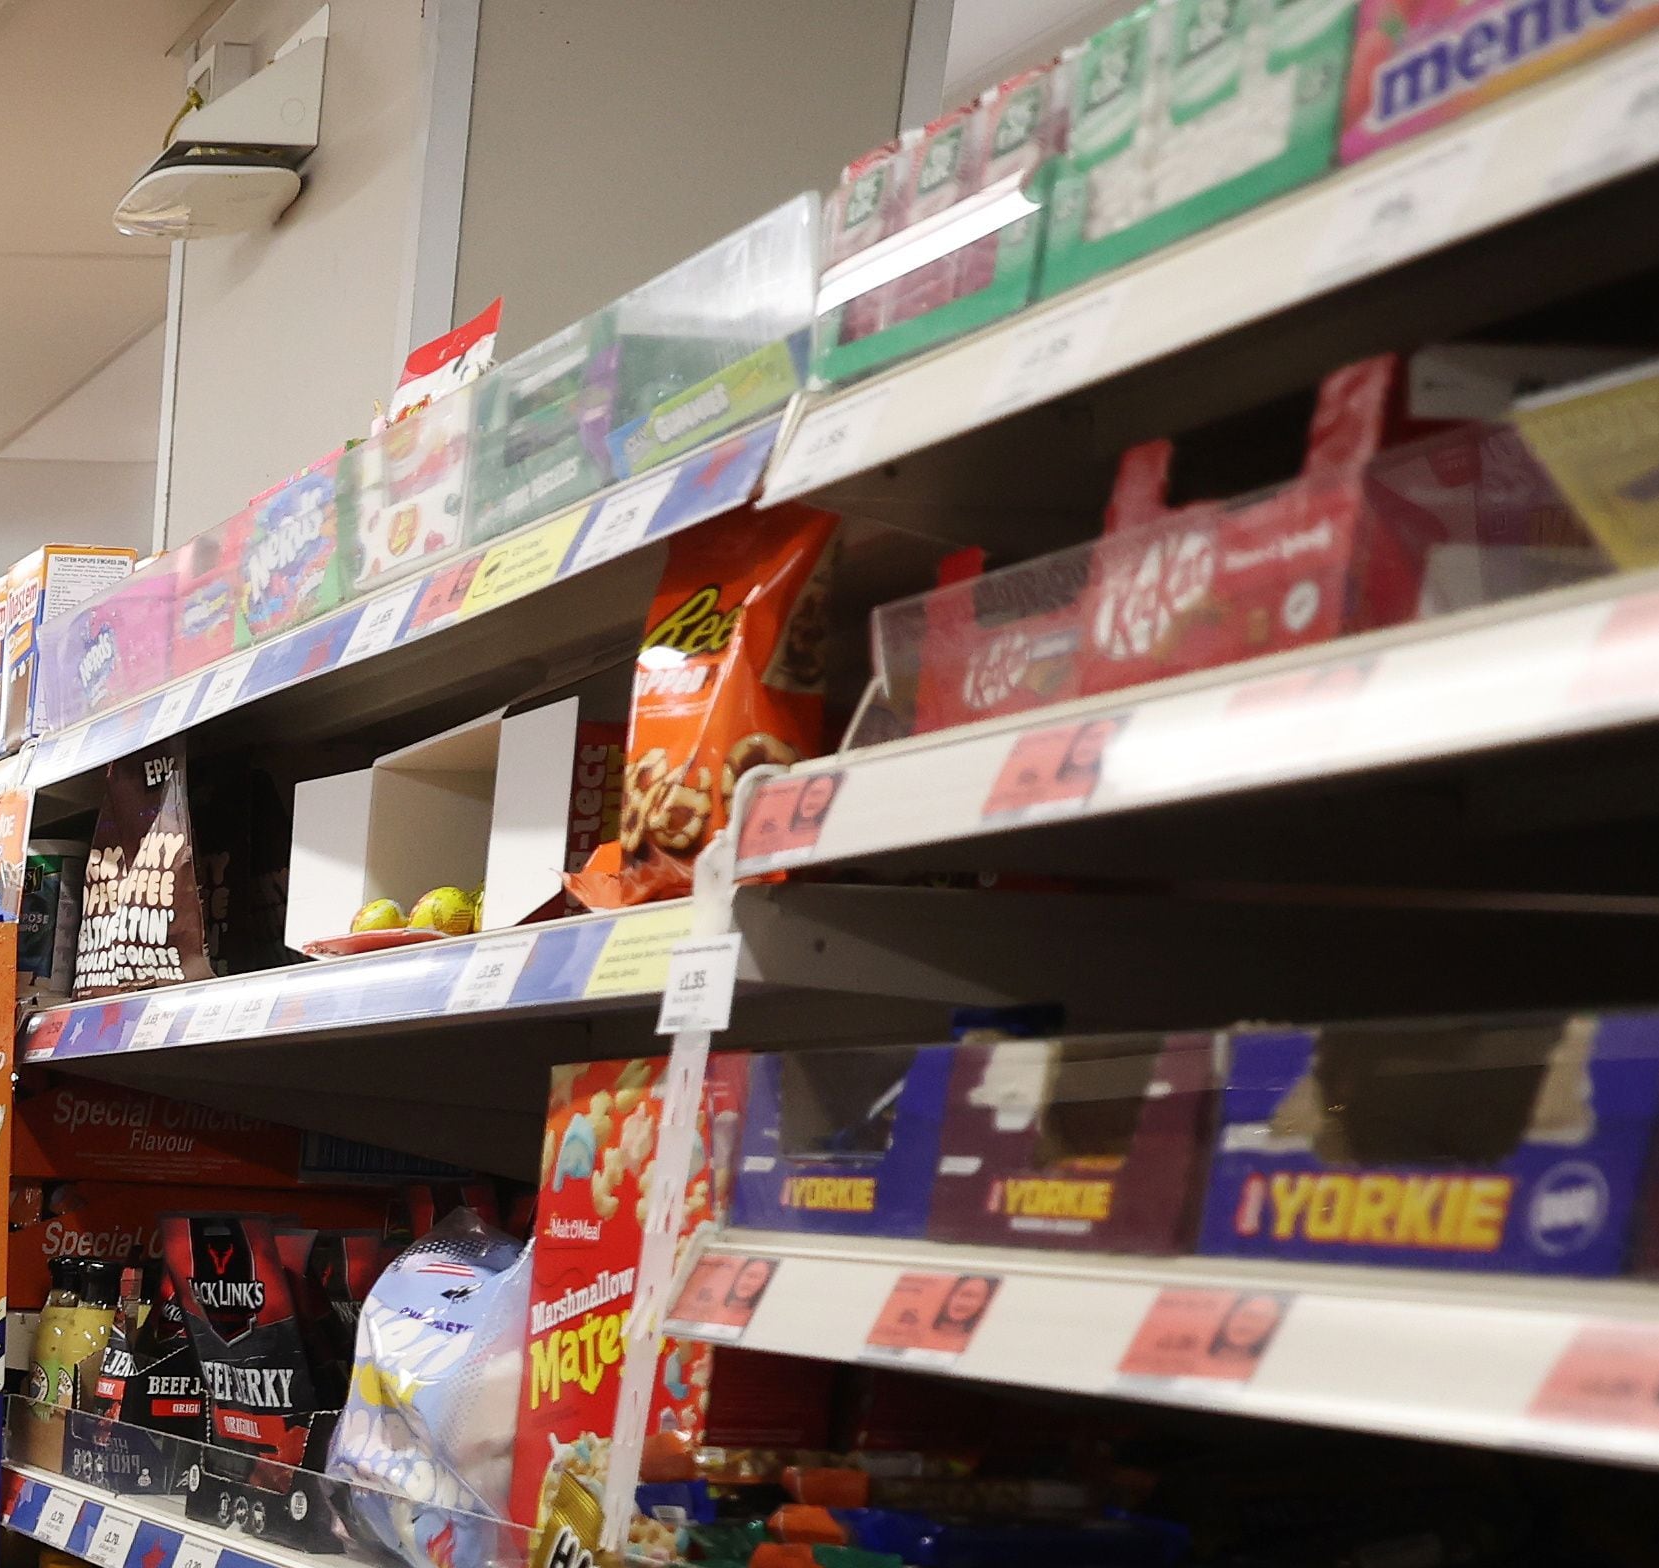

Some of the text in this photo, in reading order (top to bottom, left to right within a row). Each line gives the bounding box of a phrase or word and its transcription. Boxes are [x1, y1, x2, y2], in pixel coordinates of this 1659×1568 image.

[52, 1090, 160, 1139] Special
[129, 1129, 196, 1154] Flavour
[787, 1175, 877, 1213] YORKIE
[1001, 1177, 1114, 1222] YORKIE
[1269, 1171, 1516, 1254] YORKIE
[531, 1265, 636, 1334] Marshmallow
[147, 1376, 188, 1396] BEEF
